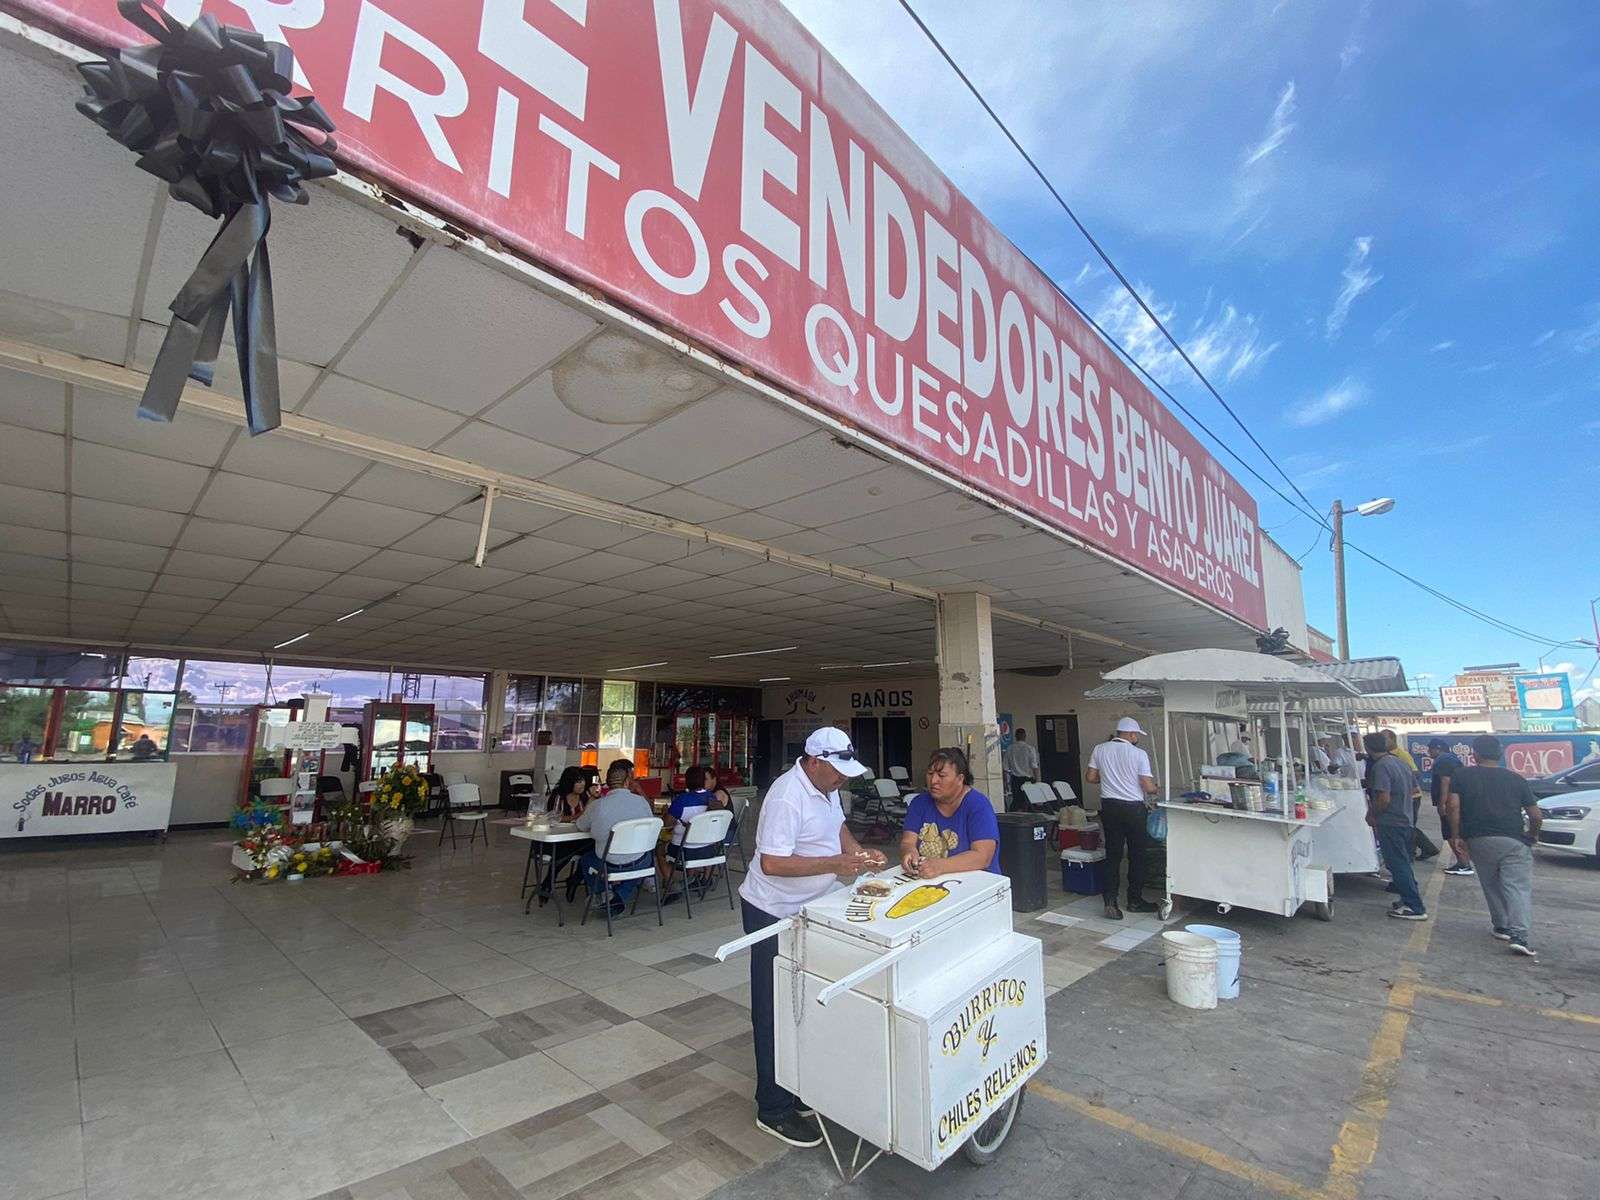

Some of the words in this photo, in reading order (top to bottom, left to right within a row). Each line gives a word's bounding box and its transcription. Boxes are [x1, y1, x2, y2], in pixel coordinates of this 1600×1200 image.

[653, 0, 1106, 481] VENDEDORES
[1110, 386, 1198, 546] BENITO
[1202, 471, 1260, 589] JUÁREZ
[805, 303, 1118, 539] QUESADILLAS
[1123, 502, 1140, 550] Y
[1147, 520, 1235, 604] ASADEROS
[851, 689, 913, 709] BAÑOS
[1444, 686, 1483, 696] ASADEROS
[1510, 749, 1565, 776] CAIC
[13, 784, 47, 813] Sodas
[42, 792, 118, 817] MARRO
[942, 977, 1028, 1057] BURRITOS
[937, 1093, 983, 1146] CHILES
[984, 1039, 1038, 1106] RELLENOS
